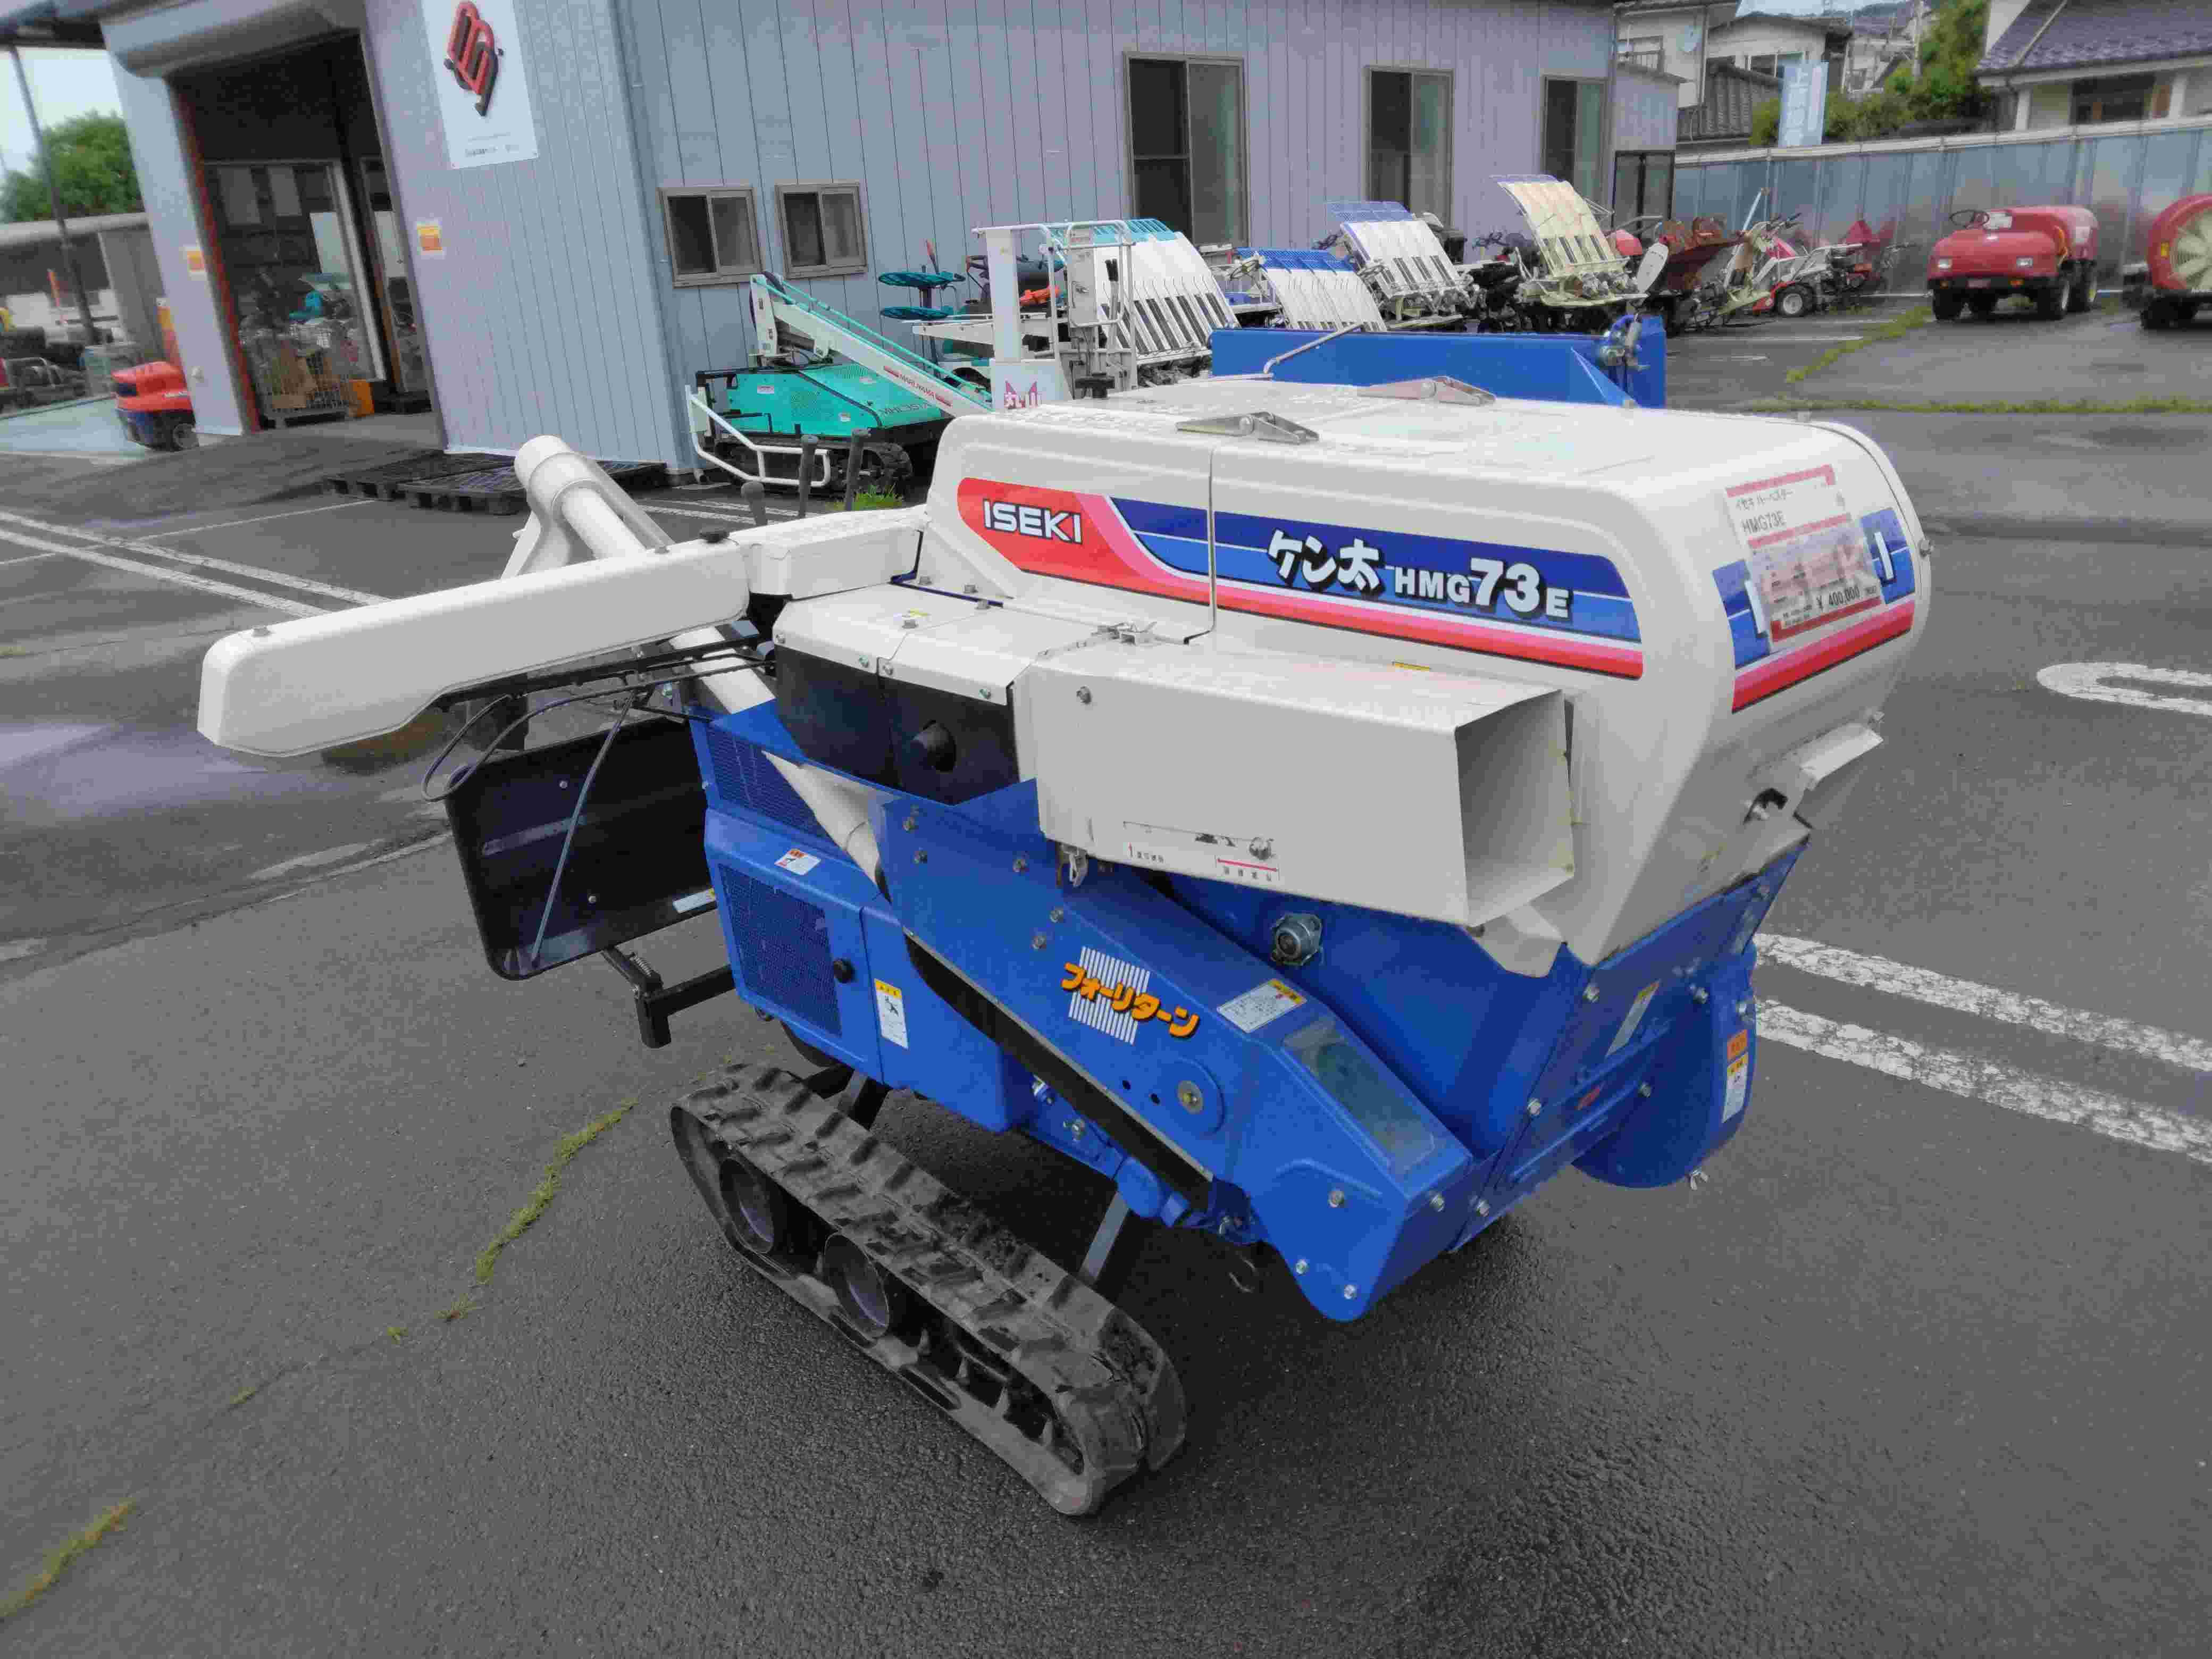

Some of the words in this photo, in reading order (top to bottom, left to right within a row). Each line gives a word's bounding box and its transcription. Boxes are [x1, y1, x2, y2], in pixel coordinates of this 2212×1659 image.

[984, 499, 1082, 544] ISEKI
[1741, 510, 1786, 534] HMG73E
[1267, 529, 1381, 592] ケン太
[1829, 584, 1860, 606] 400,000
[1061, 961, 1200, 1037] フォーリターン
